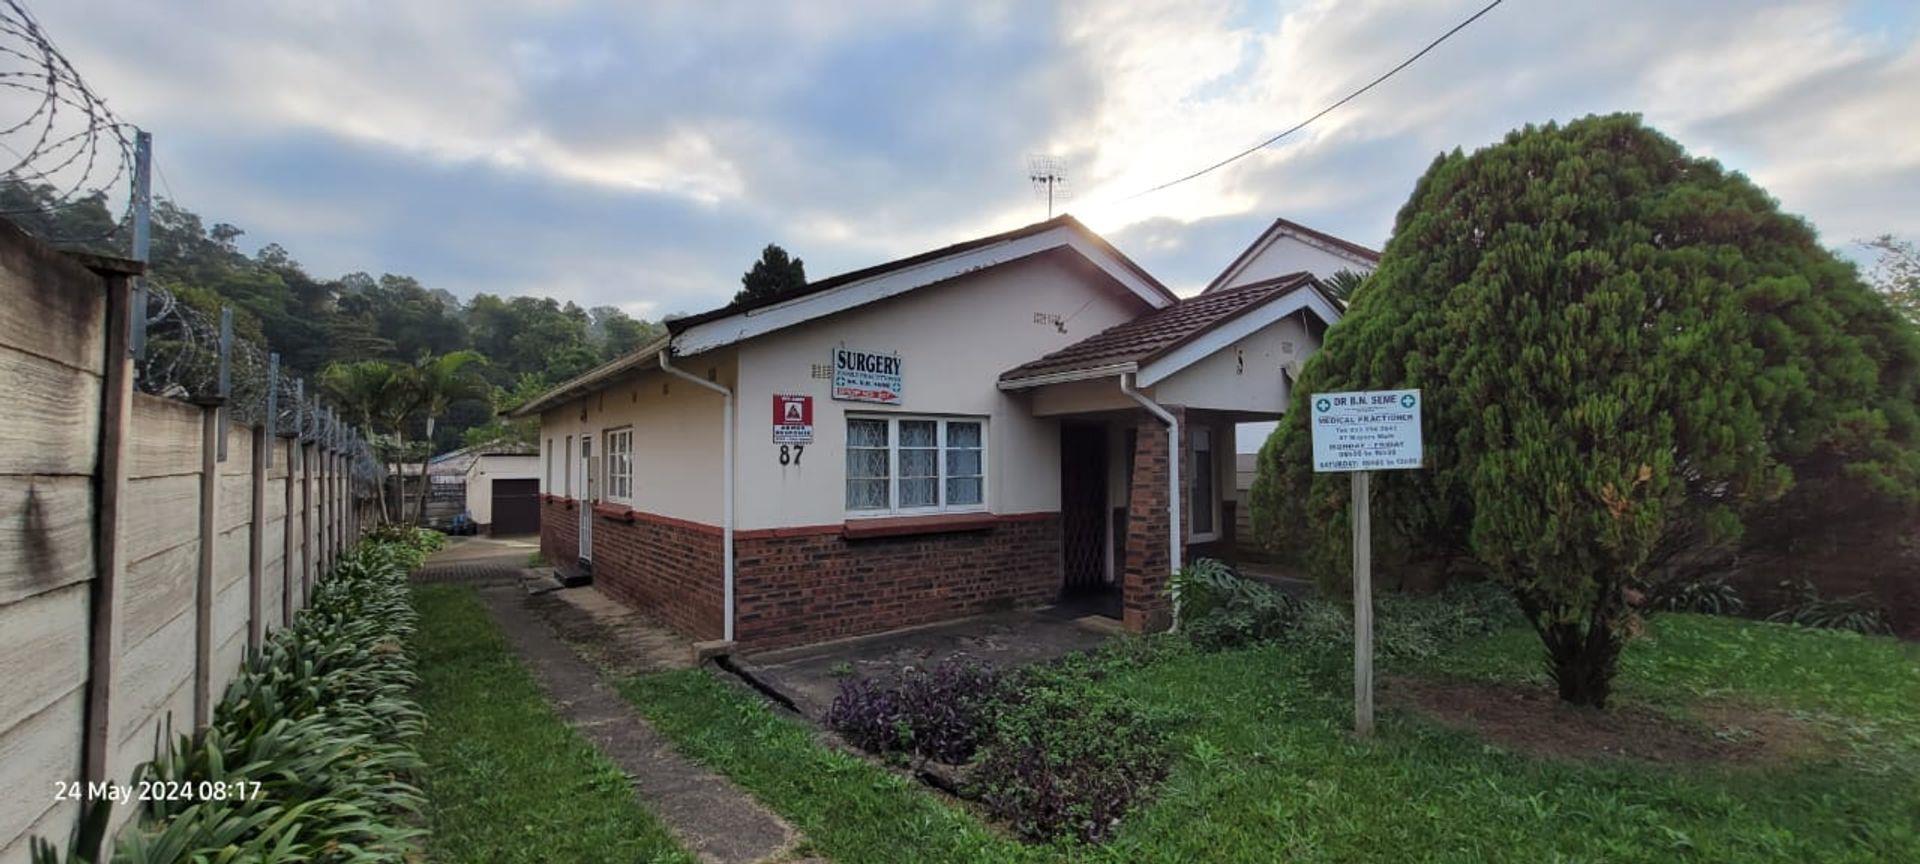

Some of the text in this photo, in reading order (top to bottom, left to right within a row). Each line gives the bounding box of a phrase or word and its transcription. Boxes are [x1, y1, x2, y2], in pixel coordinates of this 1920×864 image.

[838, 350, 901, 375] SURGERY
[1333, 397, 1347, 406] DR
[1318, 415, 1356, 424] MEDICAL
[779, 445, 804, 466] 87
